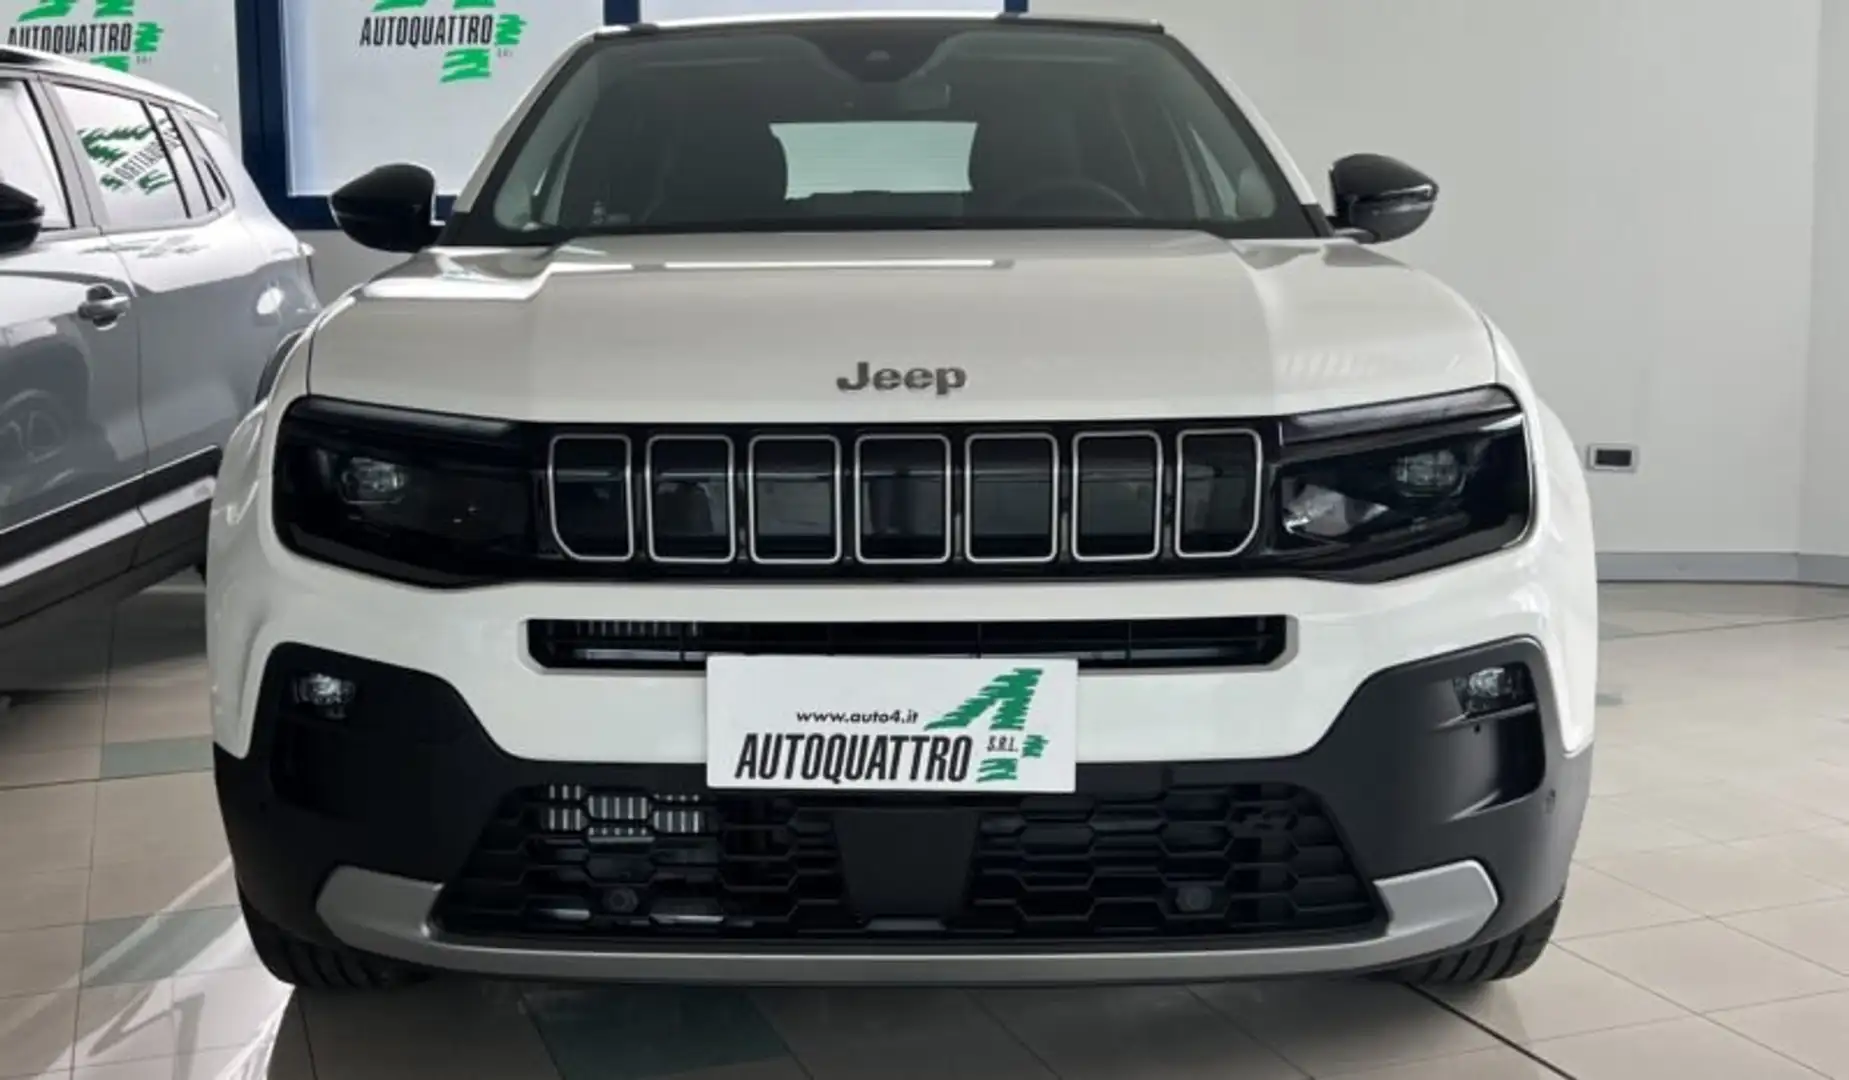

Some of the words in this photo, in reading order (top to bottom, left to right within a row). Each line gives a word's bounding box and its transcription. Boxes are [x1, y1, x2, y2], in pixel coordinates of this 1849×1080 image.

[7, 23, 132, 53] AUTOQUATTRO
[359, 15, 493, 47] AUTOQUATTRO
[836, 361, 966, 395] Jeep
[796, 709, 919, 725] www.auto4.it
[734, 733, 973, 784] AUTOQUATTRO
